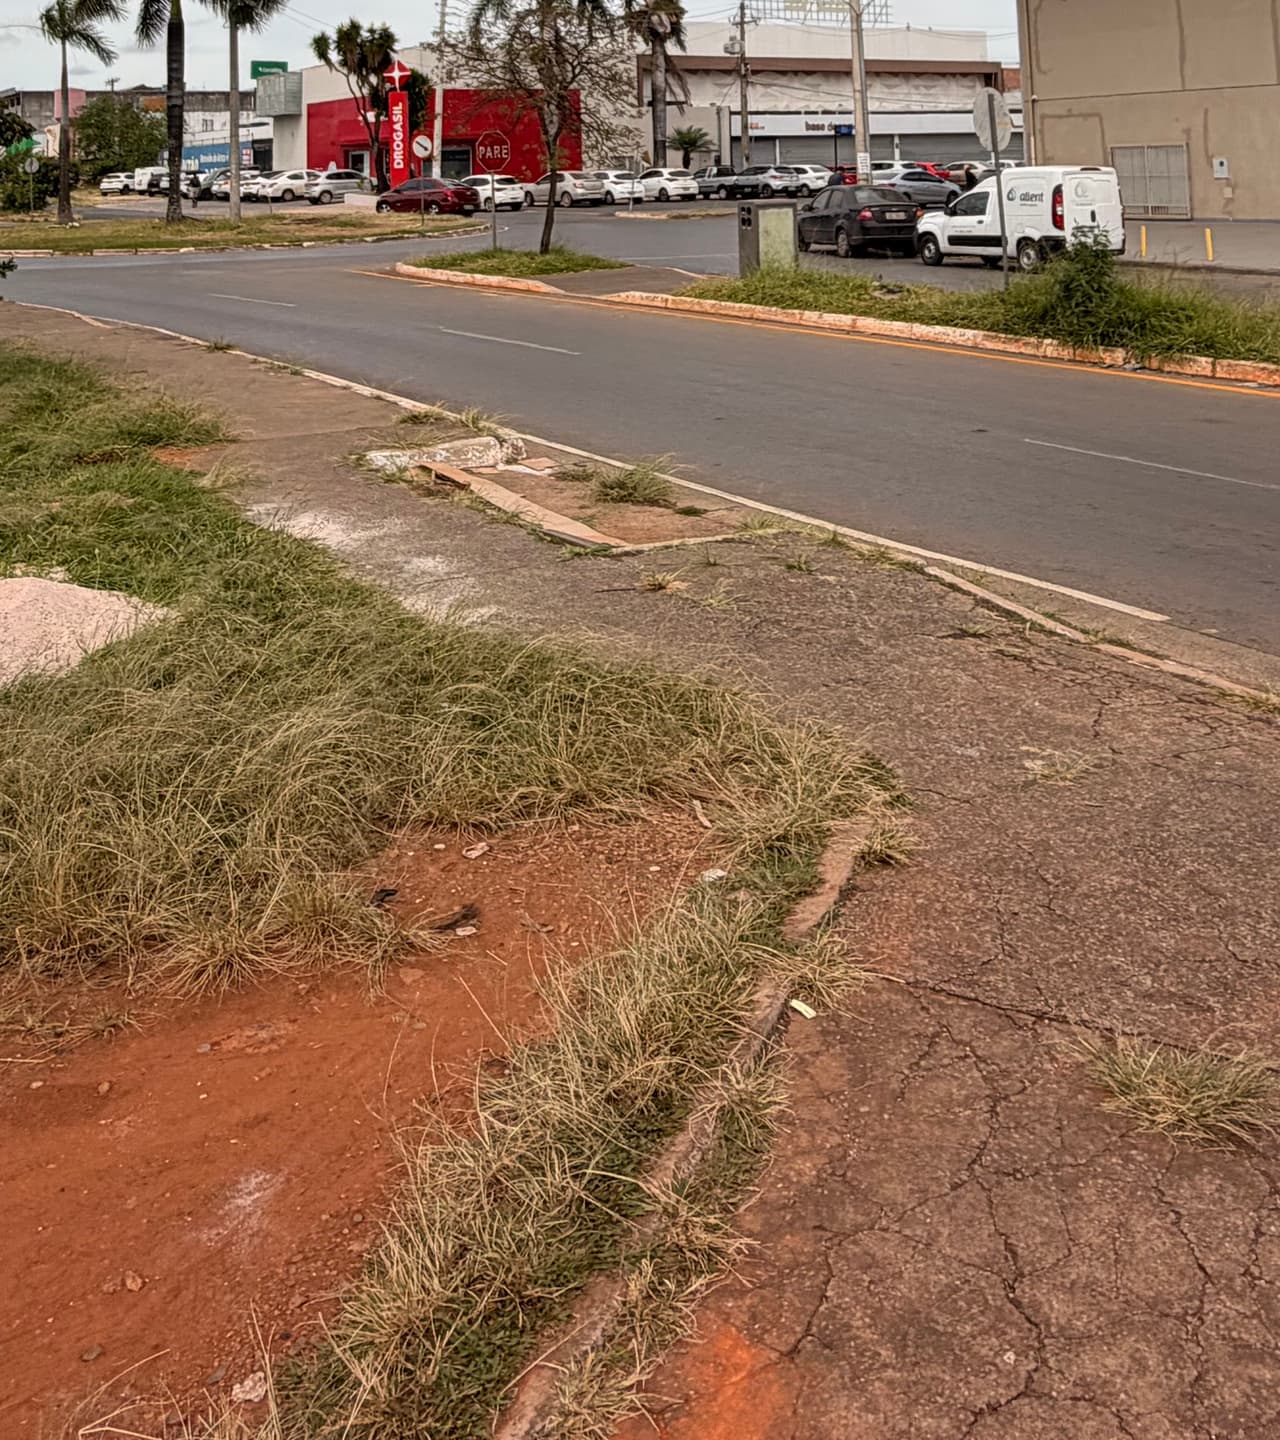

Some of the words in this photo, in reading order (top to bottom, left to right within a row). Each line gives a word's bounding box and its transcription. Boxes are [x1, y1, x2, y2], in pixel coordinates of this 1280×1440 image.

[805, 121, 825, 131] base
[392, 102, 404, 169] DROGASIL
[479, 145, 509, 159] PARE
